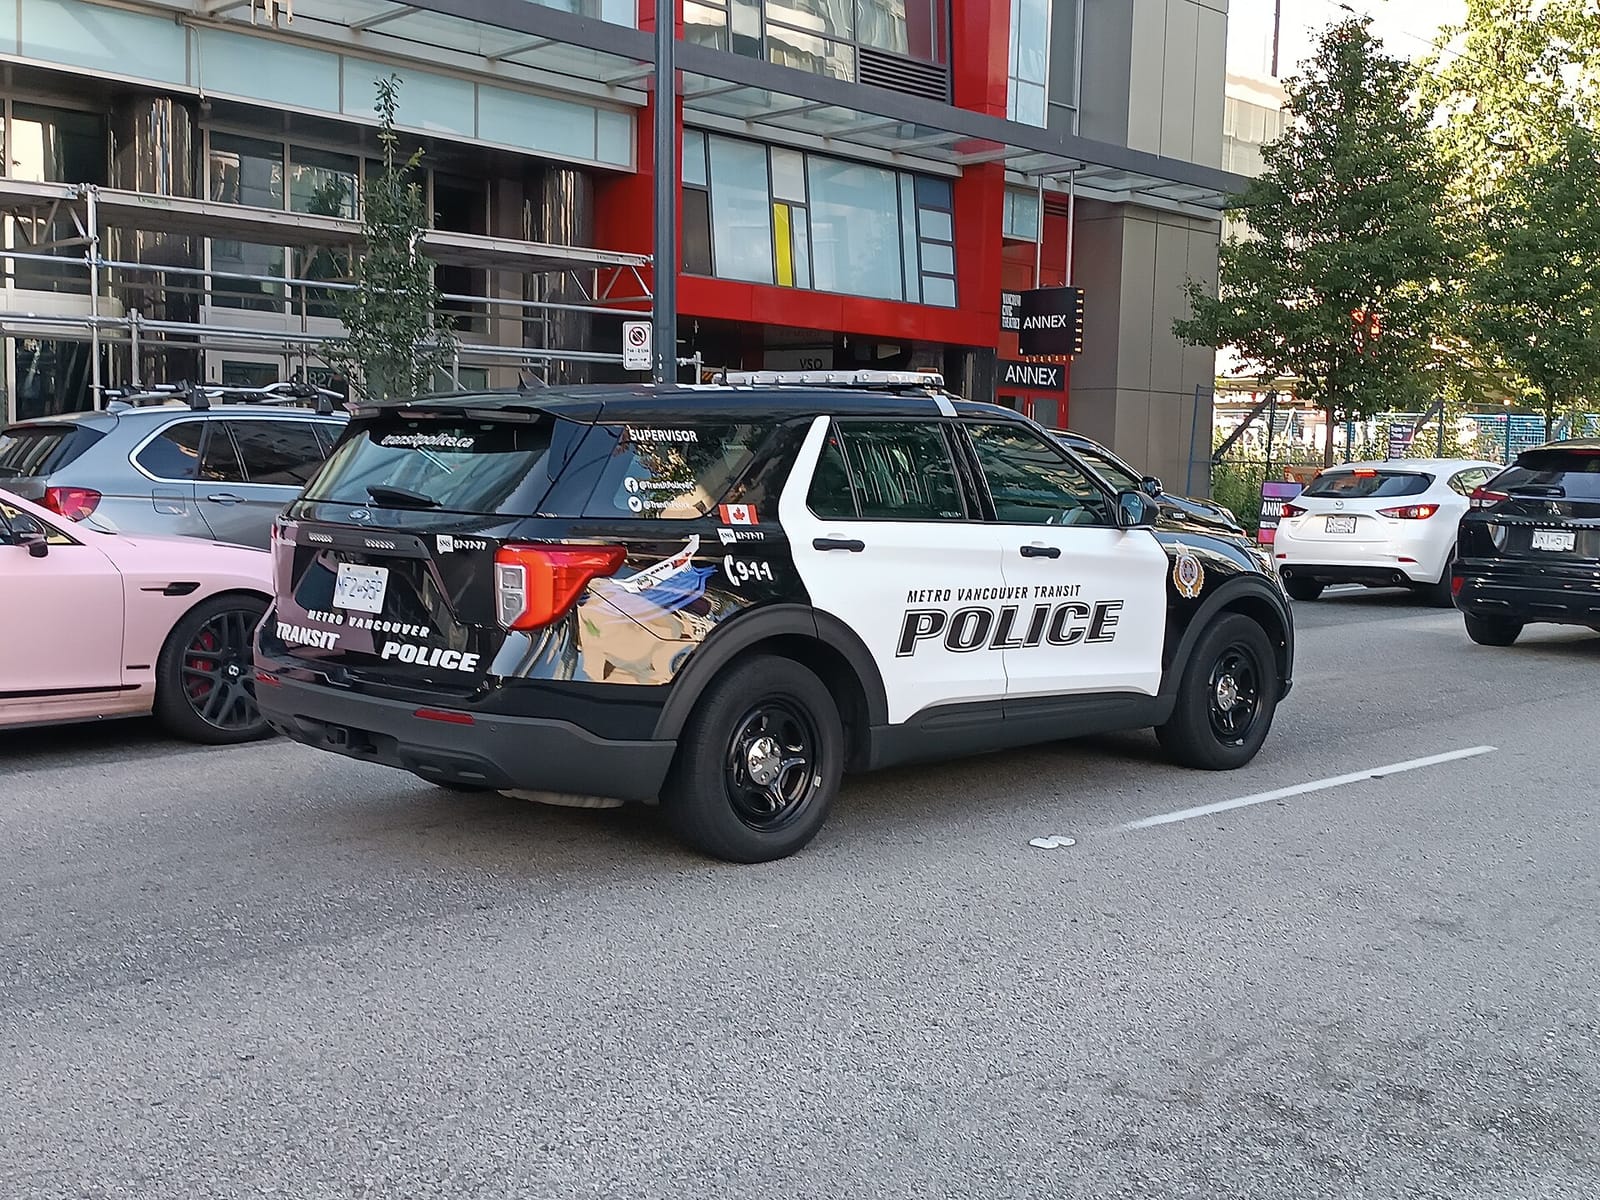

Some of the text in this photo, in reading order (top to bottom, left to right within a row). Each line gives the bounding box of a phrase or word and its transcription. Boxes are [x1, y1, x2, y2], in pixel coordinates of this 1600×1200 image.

[1023, 315, 1066, 329] ANNEX
[800, 358, 823, 369] VSO
[309, 371, 334, 388] 827
[1005, 365, 1057, 386] ANNEX
[630, 429, 699, 442] SUPERVISOR
[736, 561, 774, 581] 9-1-1
[907, 585, 1081, 603] METRO VANCOUVER TRANSIT
[307, 609, 431, 638] METRO VANCOUVER
[895, 600, 1124, 658] POLICE
[276, 621, 341, 650] TRANSIT
[381, 641, 481, 673] POLICE
